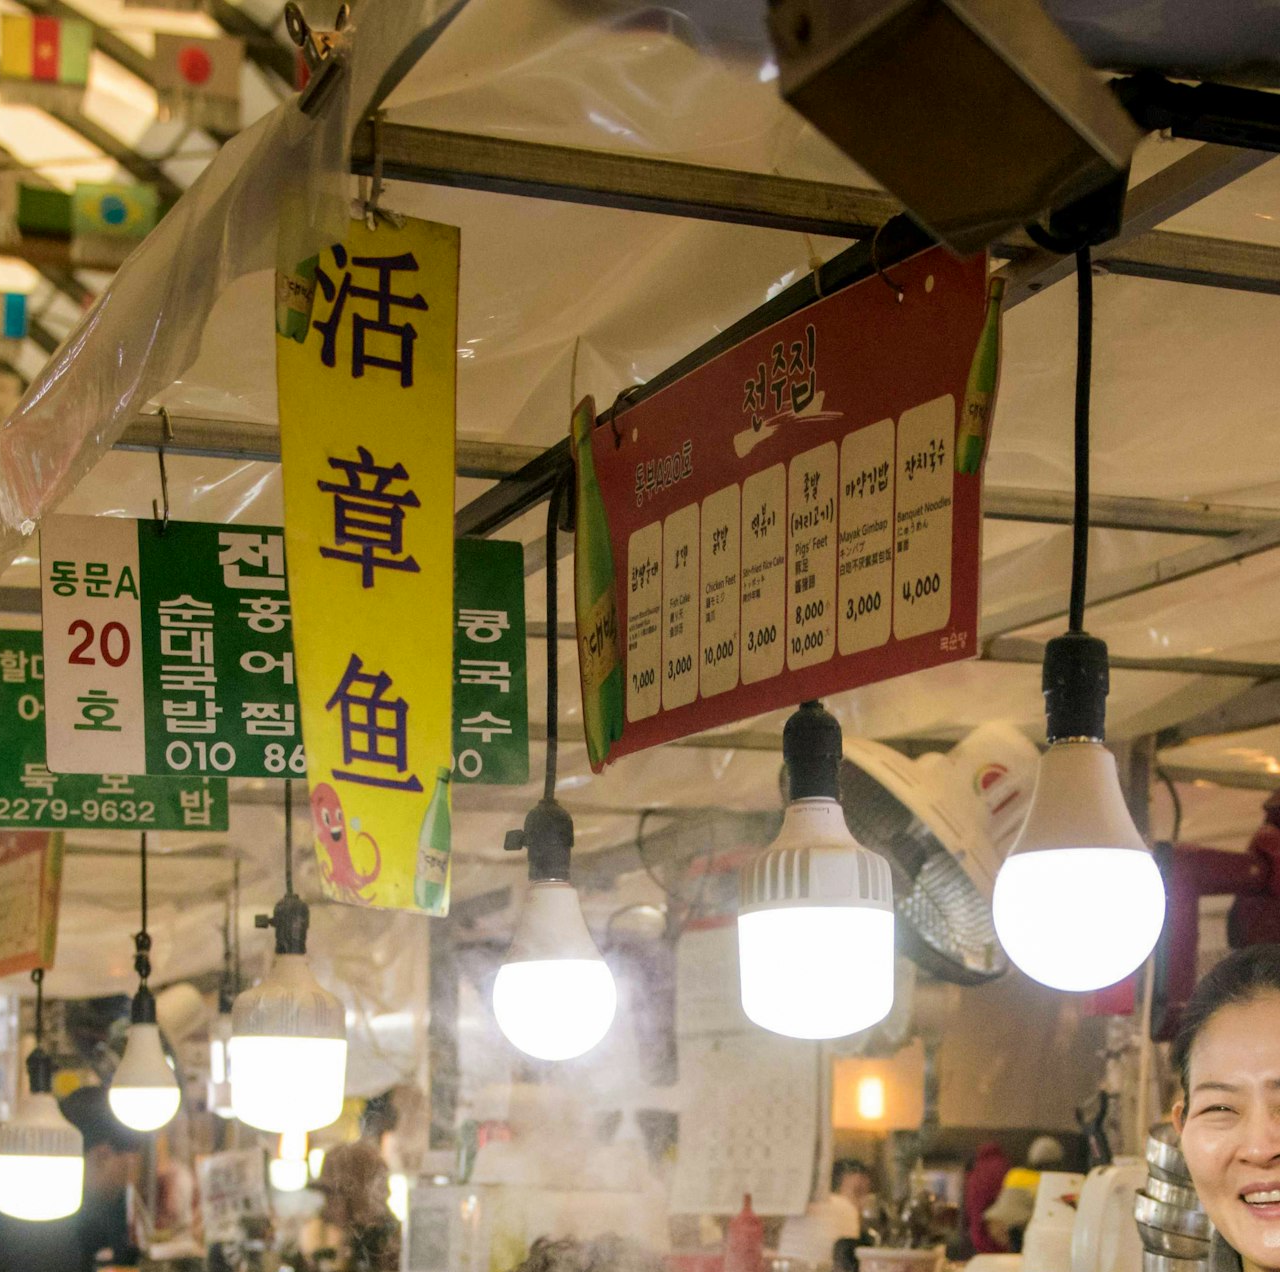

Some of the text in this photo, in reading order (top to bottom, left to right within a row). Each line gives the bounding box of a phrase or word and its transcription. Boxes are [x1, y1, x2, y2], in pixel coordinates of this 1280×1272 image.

[742, 324, 816, 432] 전주집
[845, 461, 889, 498] 마약김밥
[313, 244, 429, 794] 活章鱼
[924, 496, 951, 513] Noodles
[812, 535, 828, 549] Feet
[862, 519, 888, 537] Gimbap
[50, 561, 139, 600] 동문A
[902, 573, 941, 605] 4,000
[795, 599, 824, 627] 8,000
[846, 591, 881, 621] 3,000
[67, 619, 131, 667] 20
[704, 640, 734, 666] 10,000
[748, 624, 776, 653] 3,000
[791, 630, 824, 656] 10,000
[158, 594, 223, 734] 순대국밥
[458, 609, 513, 743] 콩국수
[668, 655, 692, 682] 3,000
[633, 669, 655, 694] 7,000
[73, 690, 122, 732] 호
[166, 741, 236, 771] 010
